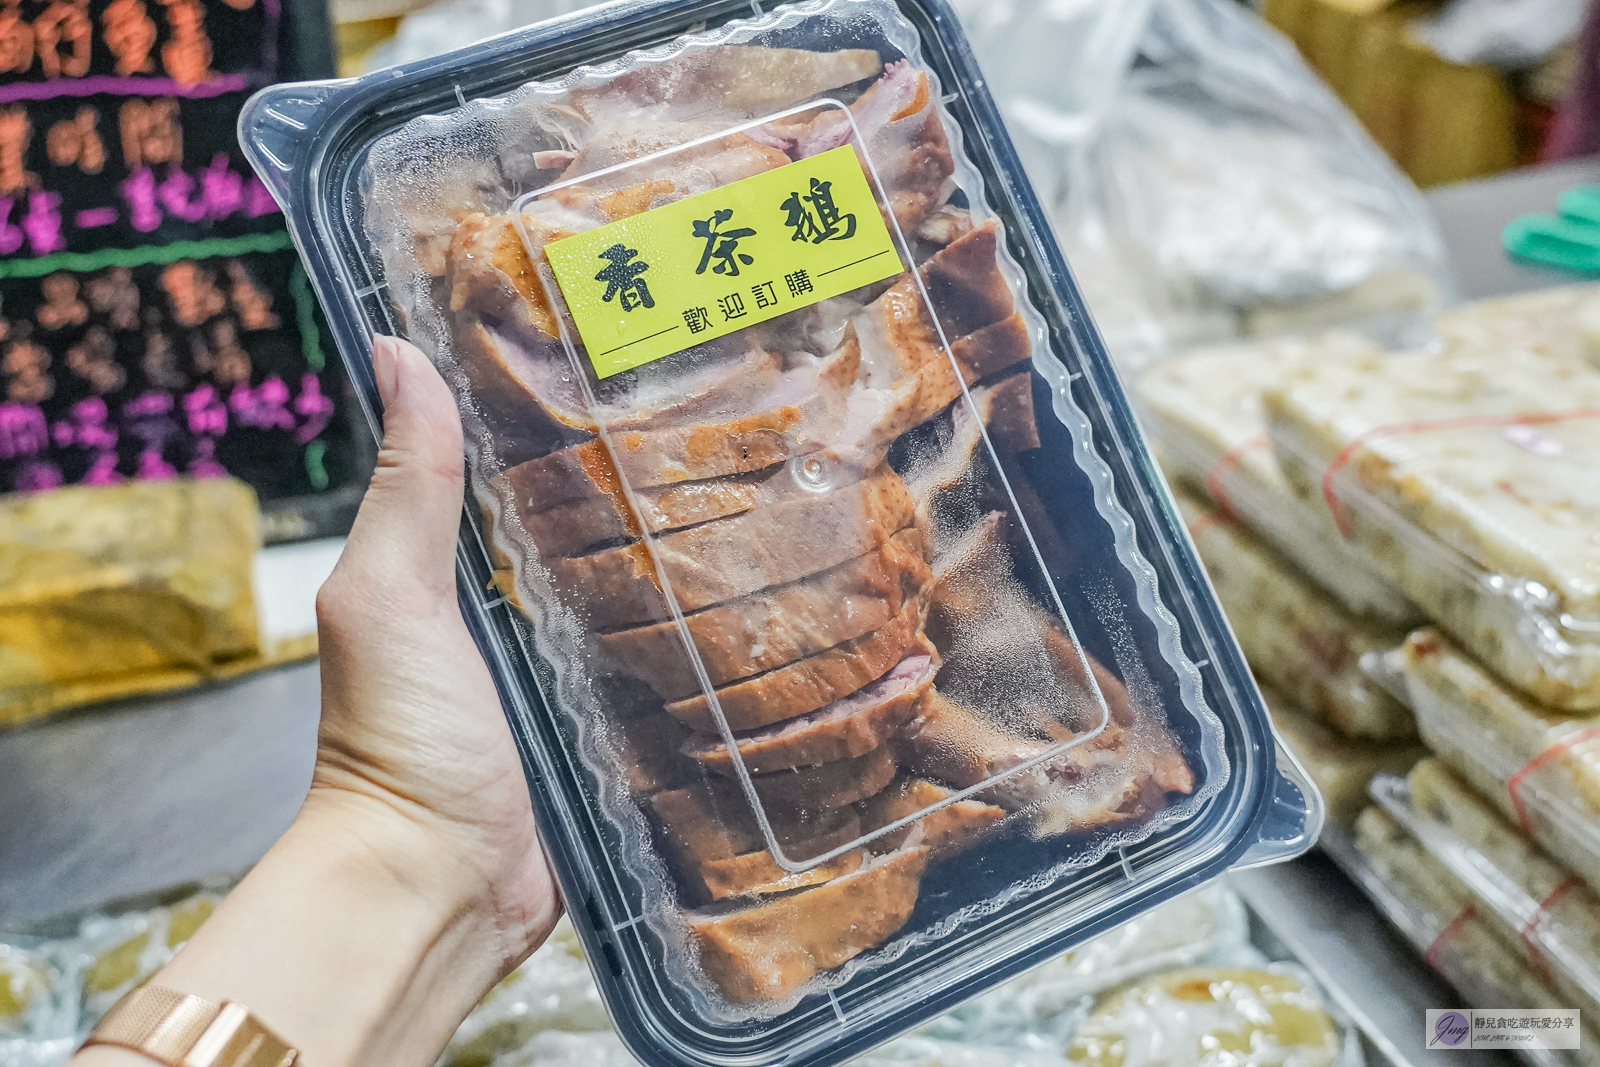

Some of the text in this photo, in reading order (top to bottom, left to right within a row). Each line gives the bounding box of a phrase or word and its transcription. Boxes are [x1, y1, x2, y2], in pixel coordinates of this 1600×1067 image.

[594, 177, 857, 313] 香茶鵝
[682, 268, 815, 335] 歡迎訂購
